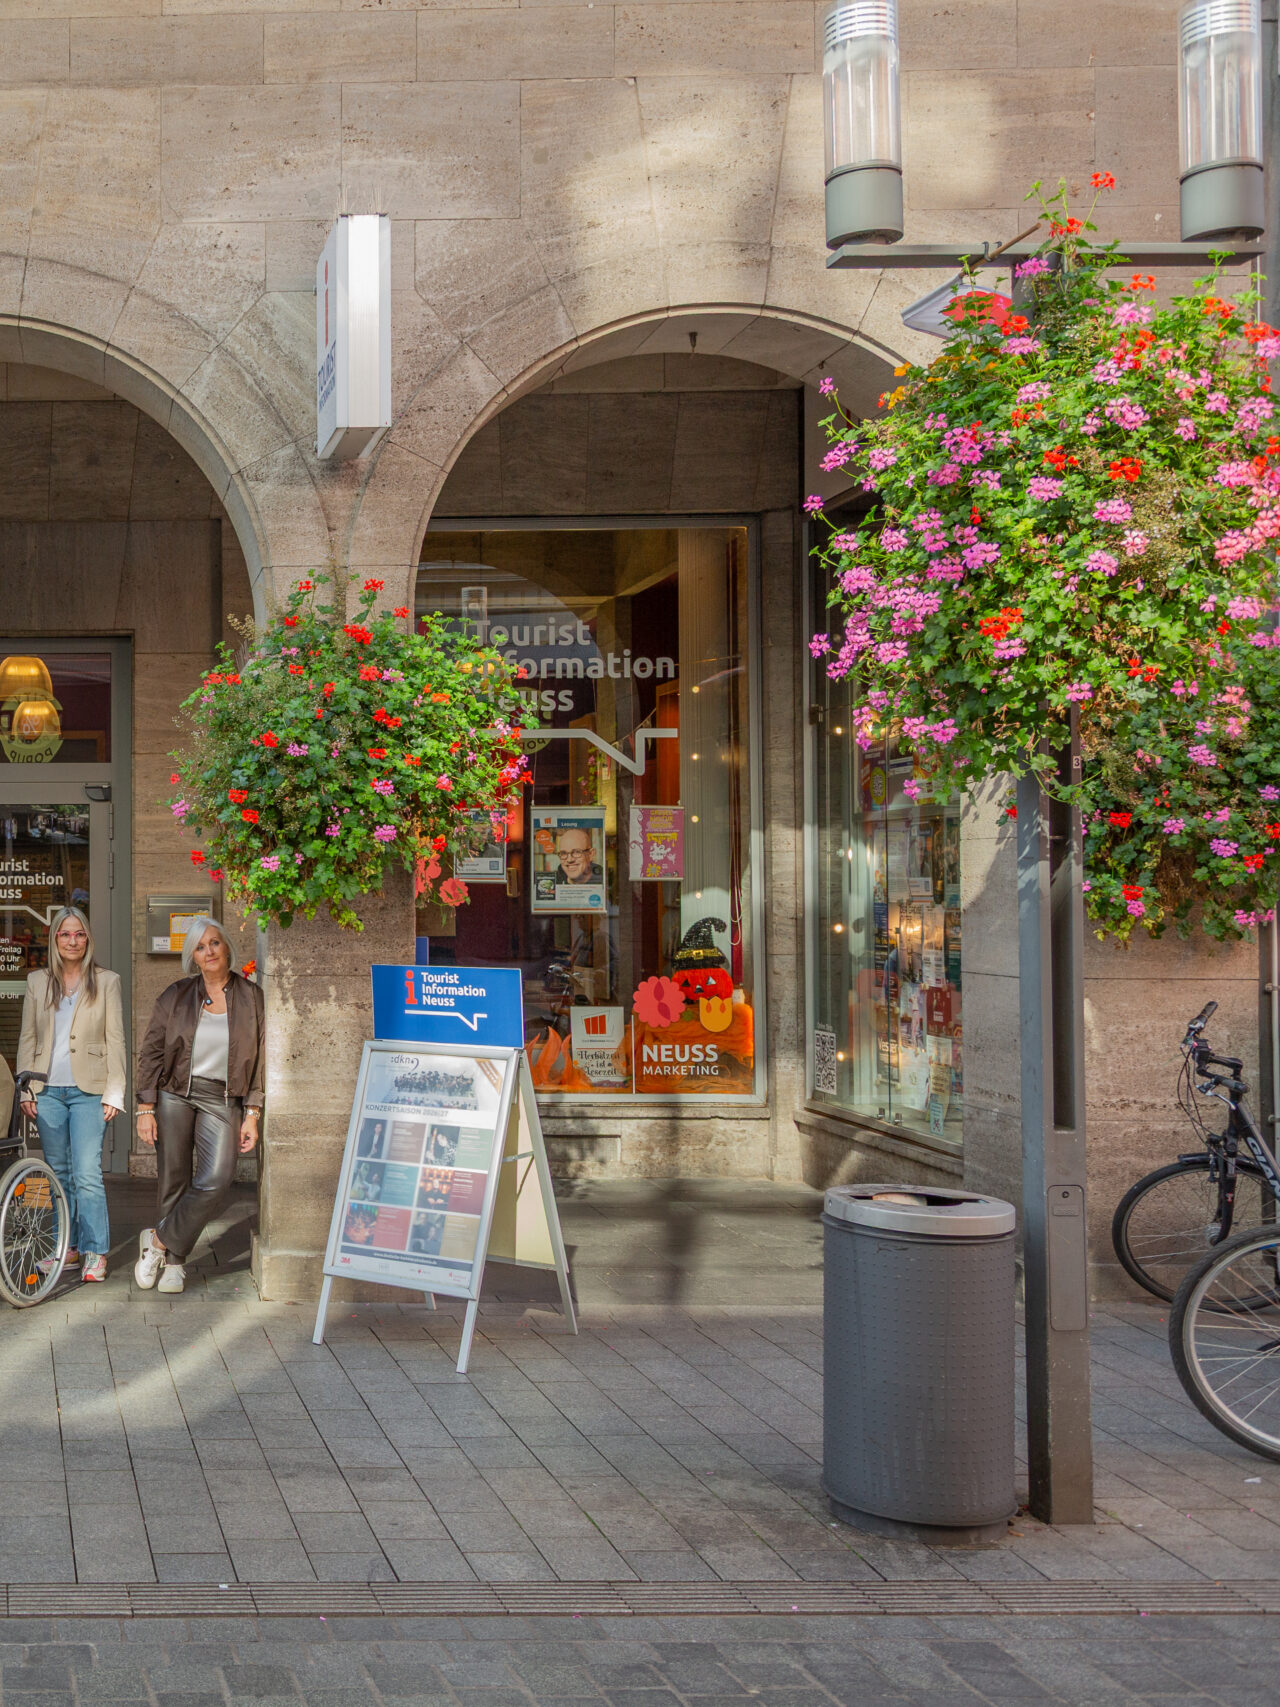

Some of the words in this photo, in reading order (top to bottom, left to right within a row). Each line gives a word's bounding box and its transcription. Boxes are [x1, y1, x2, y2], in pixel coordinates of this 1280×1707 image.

[474, 617, 591, 646] Tourist
[1074, 757, 1080, 767] 3
[421, 972, 459, 984] Tourist
[405, 970, 418, 1005] i
[422, 984, 486, 997] Information
[422, 995, 455, 1006] Neuss
[643, 1044, 718, 1062] NEUSS
[643, 1065, 719, 1075] MARKETING
[365, 1104, 421, 1115] KONZERTSAISON
